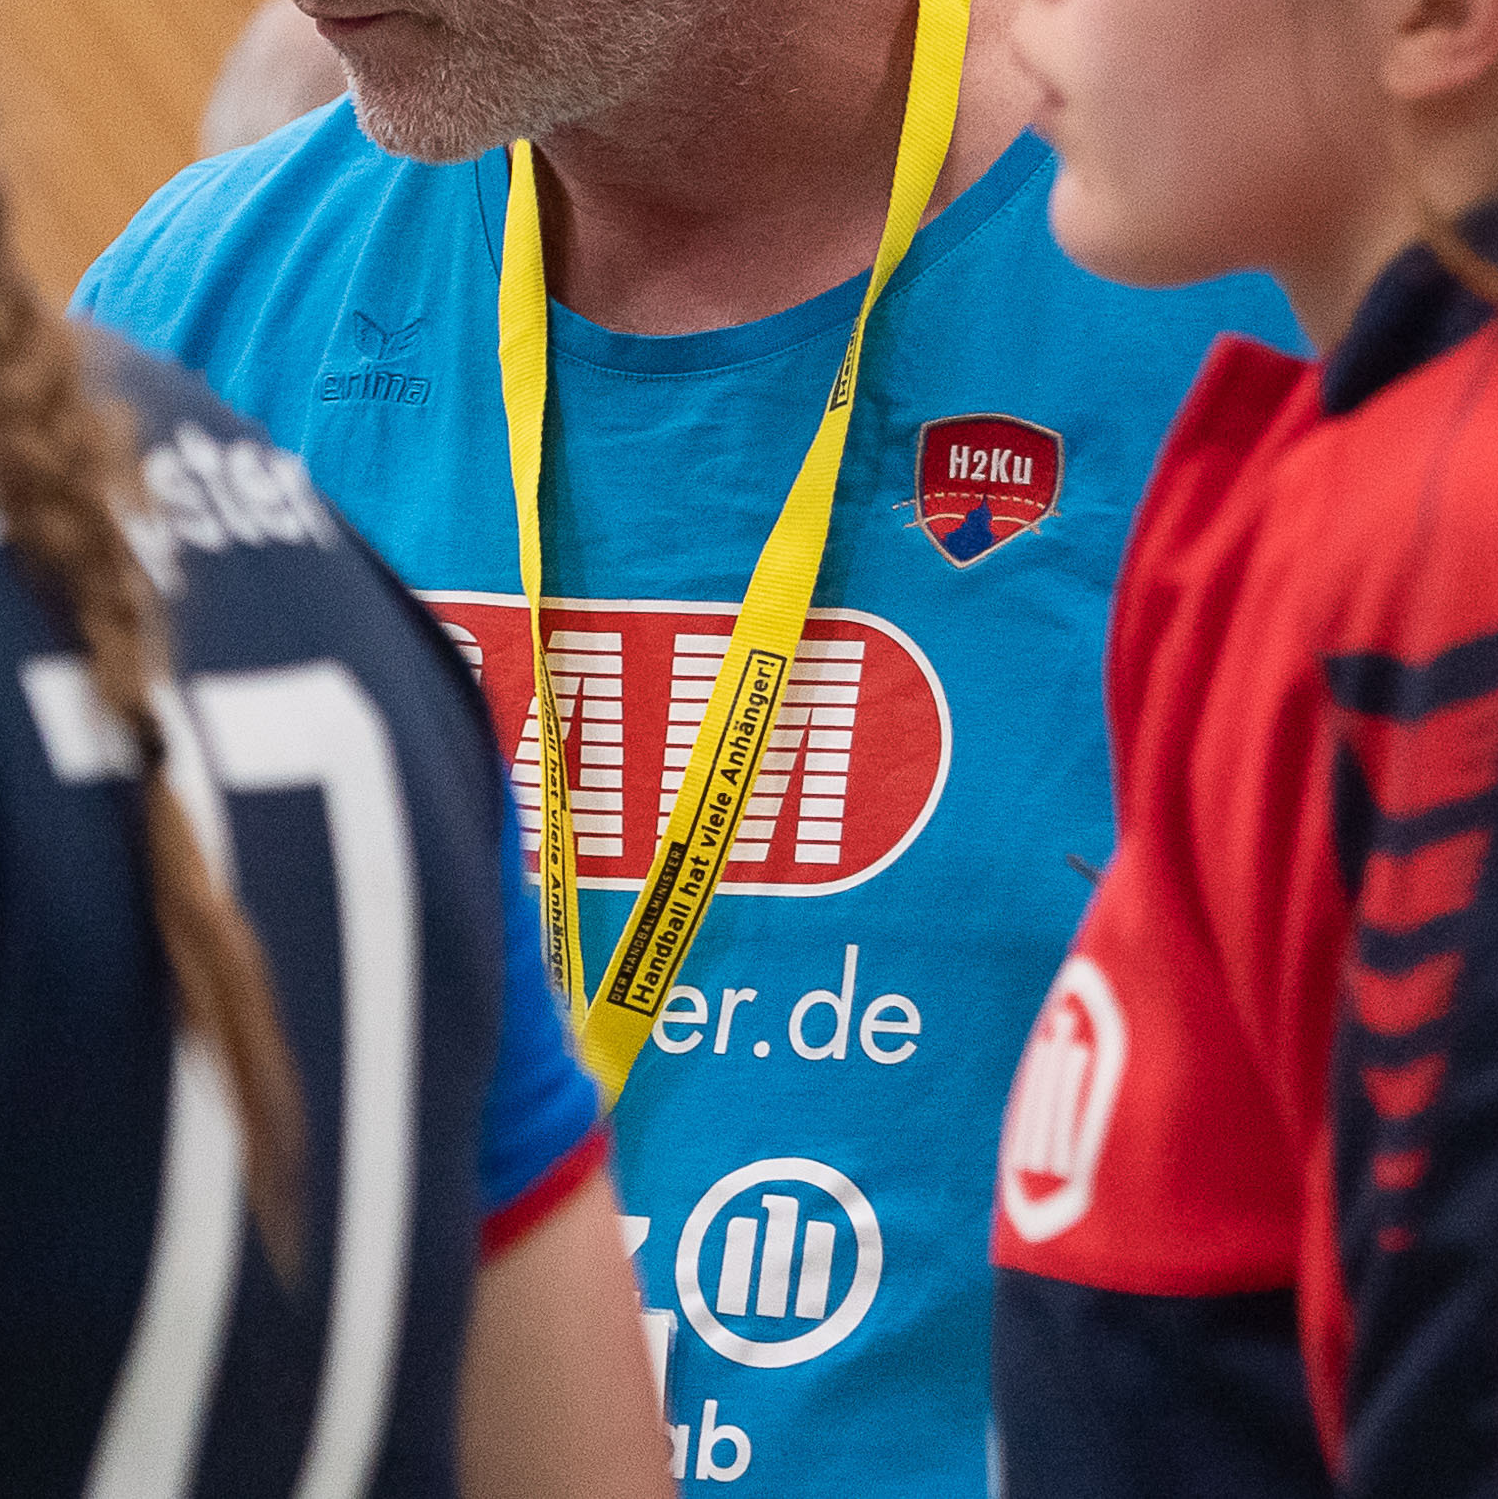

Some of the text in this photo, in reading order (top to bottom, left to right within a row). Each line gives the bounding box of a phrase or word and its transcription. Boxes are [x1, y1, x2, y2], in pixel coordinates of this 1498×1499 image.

[320, 363, 432, 405] erima
[948, 444, 1034, 486] H2Ku
[631, 658, 776, 1004] Handball hat viele Anhänger!
[610, 974, 628, 1003] DER
[651, 943, 922, 1065] er.de
